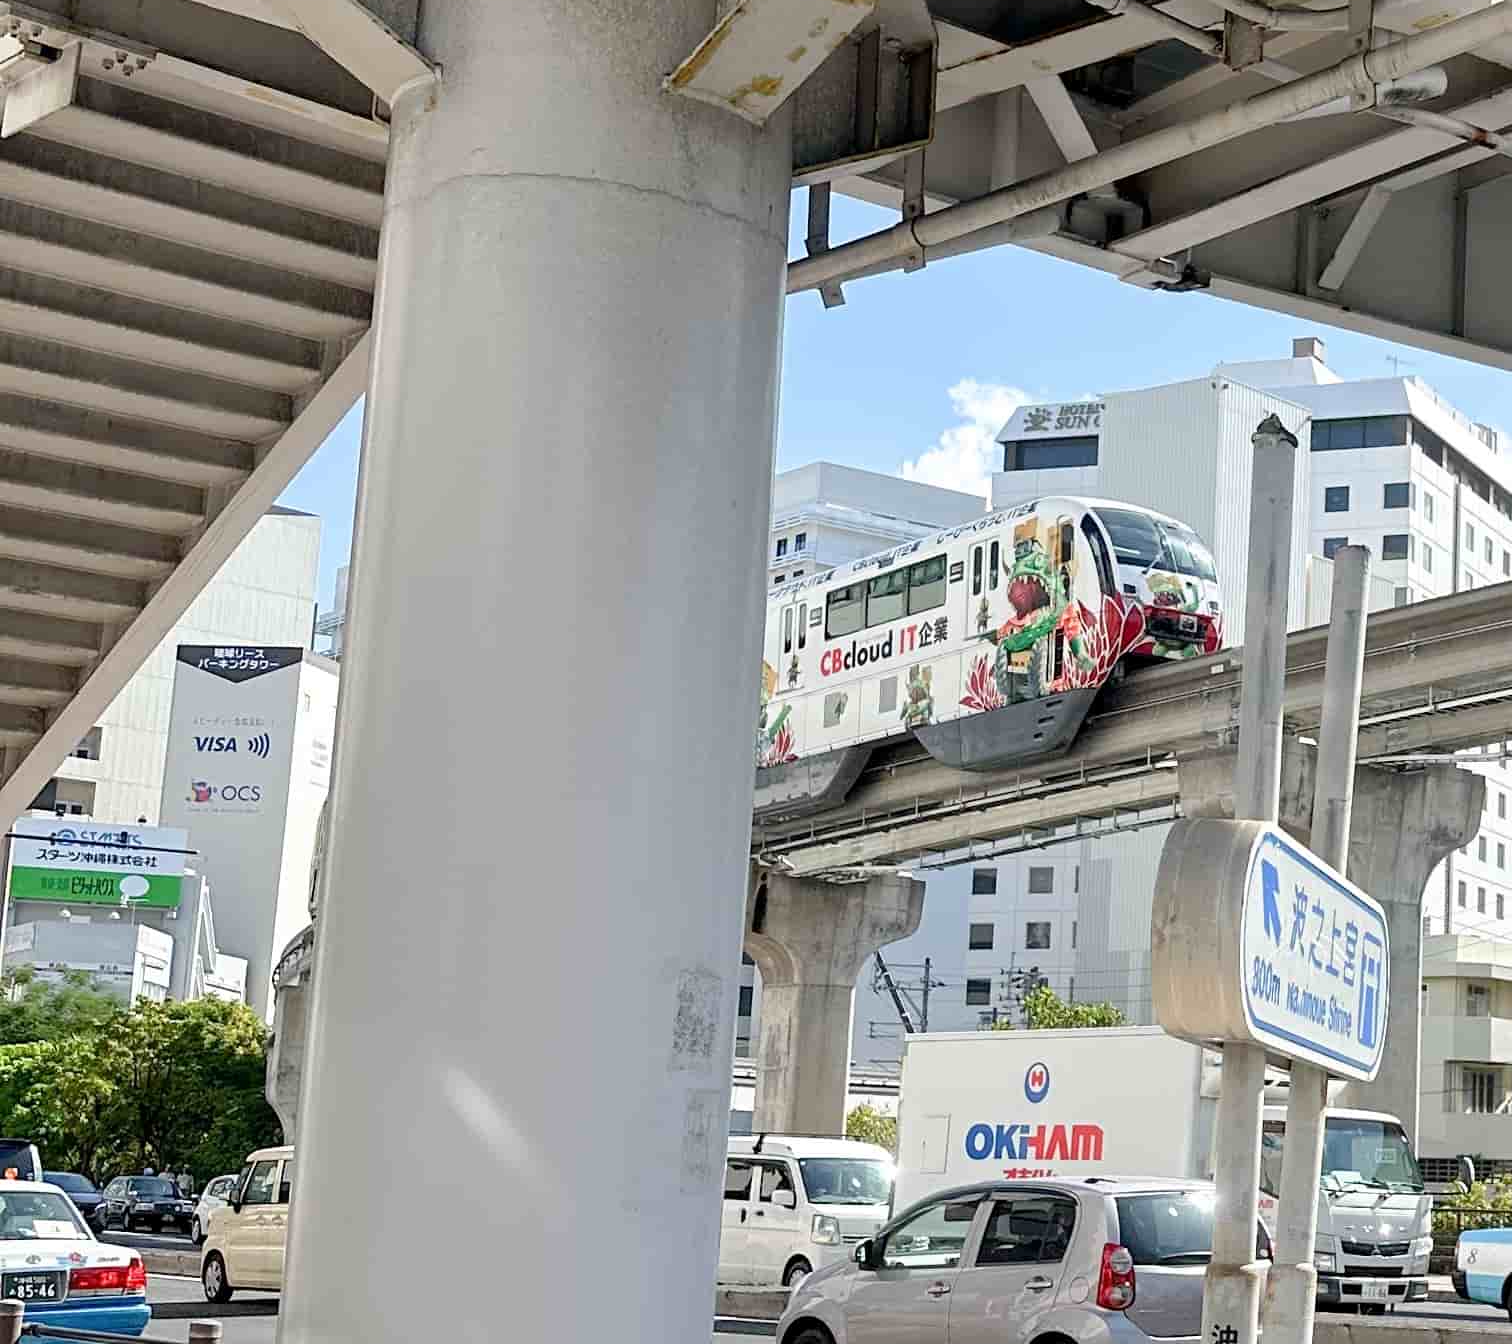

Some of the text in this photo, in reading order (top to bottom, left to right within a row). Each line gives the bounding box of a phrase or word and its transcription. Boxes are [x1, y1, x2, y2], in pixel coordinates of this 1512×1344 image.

[1055, 416, 1089, 429] SUN
[820, 616, 949, 677] CBcloud IT企業
[198, 658, 280, 670] パーキングタワー
[193, 736, 238, 753] VISA
[221, 785, 262, 802] OCS
[1251, 955, 1281, 1006] 800m
[17, 1283, 55, 1298] 85-46
